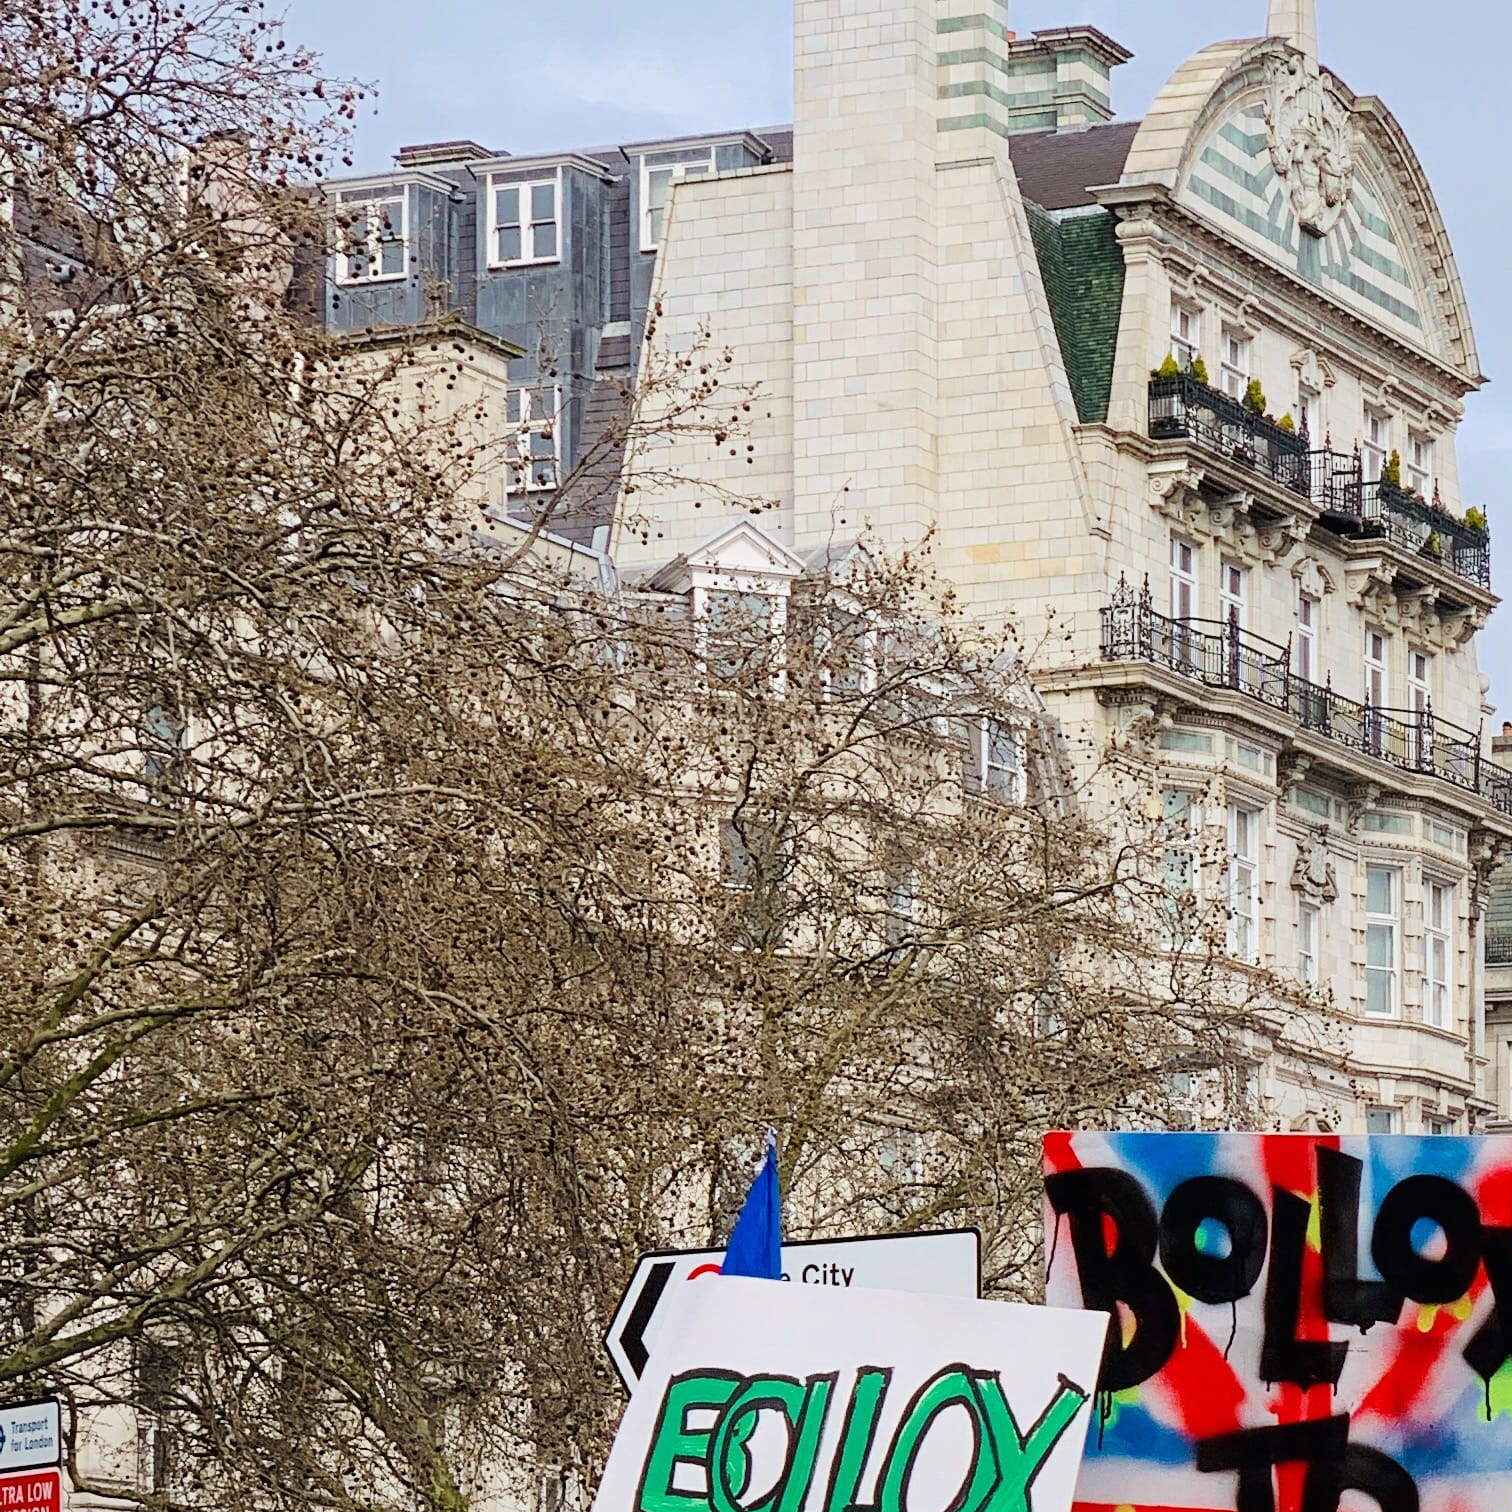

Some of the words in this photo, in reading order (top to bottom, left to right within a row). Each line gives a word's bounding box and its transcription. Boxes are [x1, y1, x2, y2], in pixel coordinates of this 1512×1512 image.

[802, 1263, 854, 1287] City
[11, 1416, 48, 1434] Transport
[11, 1438, 22, 1452] for
[25, 1434, 53, 1450] London
[0, 1485, 24, 1505] TRA
[27, 1481, 53, 1503] LOW
